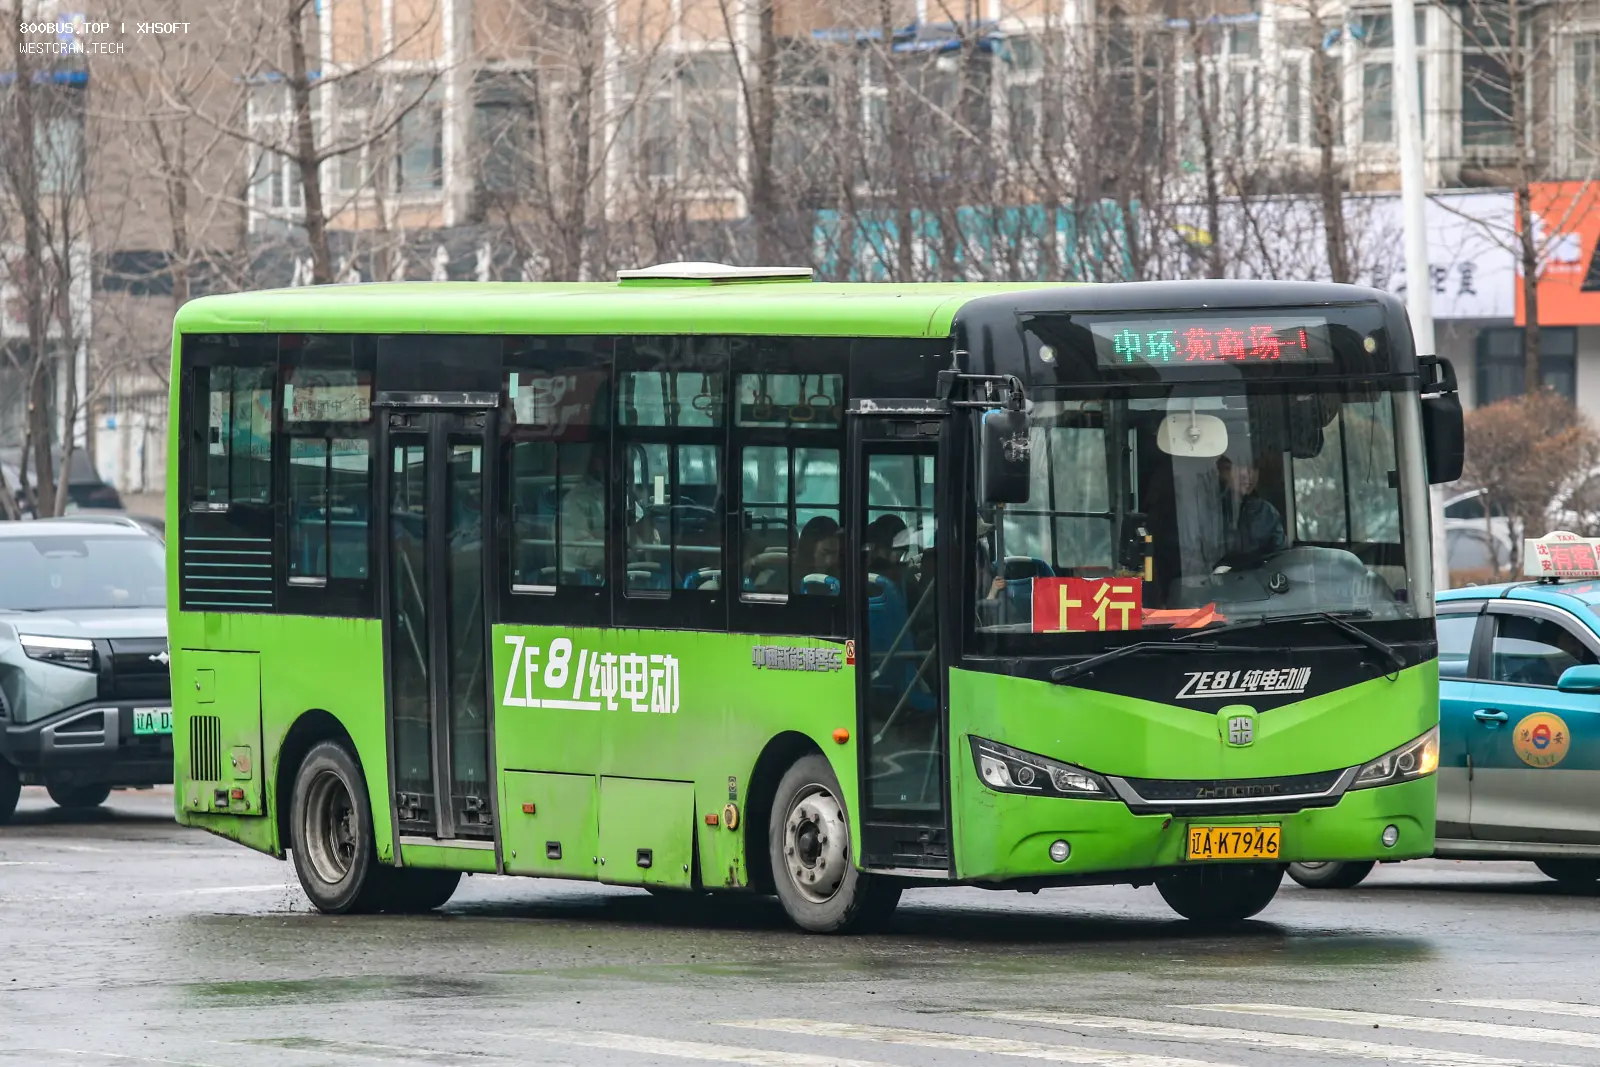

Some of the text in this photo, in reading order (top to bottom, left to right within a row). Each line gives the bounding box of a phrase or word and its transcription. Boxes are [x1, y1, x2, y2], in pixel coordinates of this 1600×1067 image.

[1549, 545, 1595, 571] 有客
[1042, 581, 1136, 633] 上行
[751, 644, 842, 672] 中通新能源客车
[1191, 831, 1278, 854] 辽A·K7946
